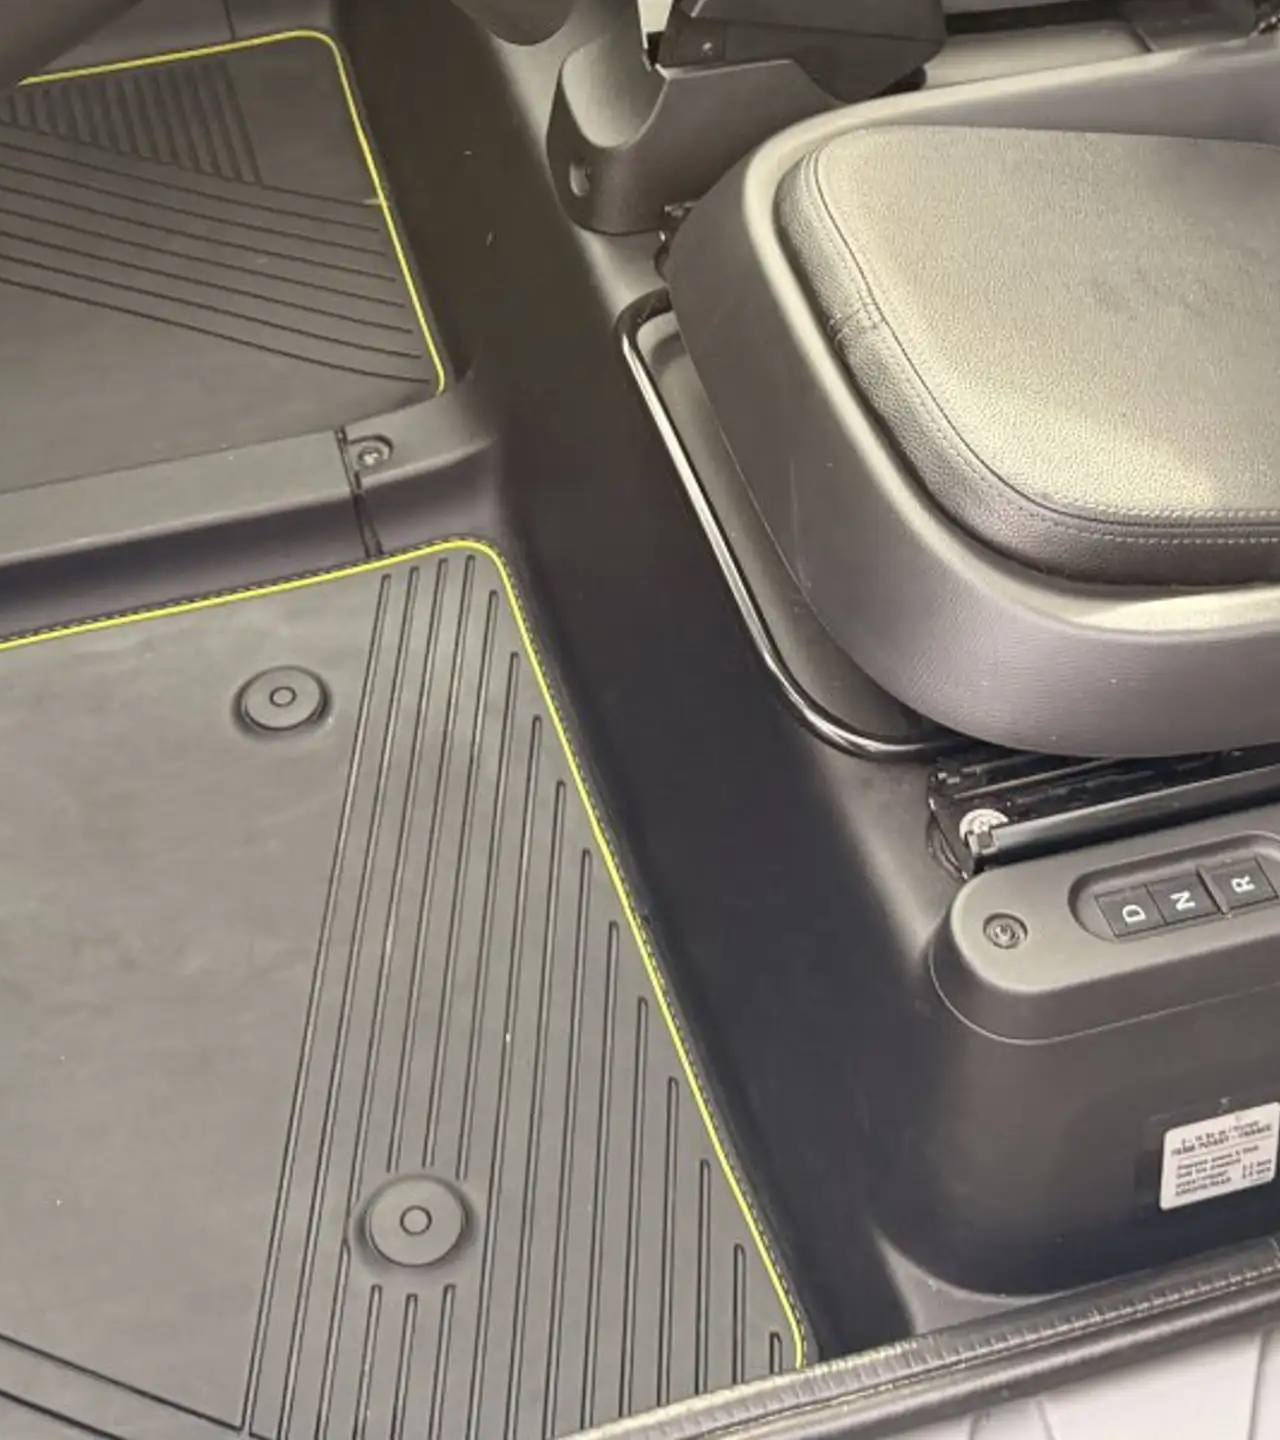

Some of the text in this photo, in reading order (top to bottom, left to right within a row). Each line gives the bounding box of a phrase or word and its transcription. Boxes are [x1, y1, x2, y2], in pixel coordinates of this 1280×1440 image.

[1231, 876, 1256, 894] R
[1170, 890, 1196, 911] N
[1122, 904, 1146, 923] D
